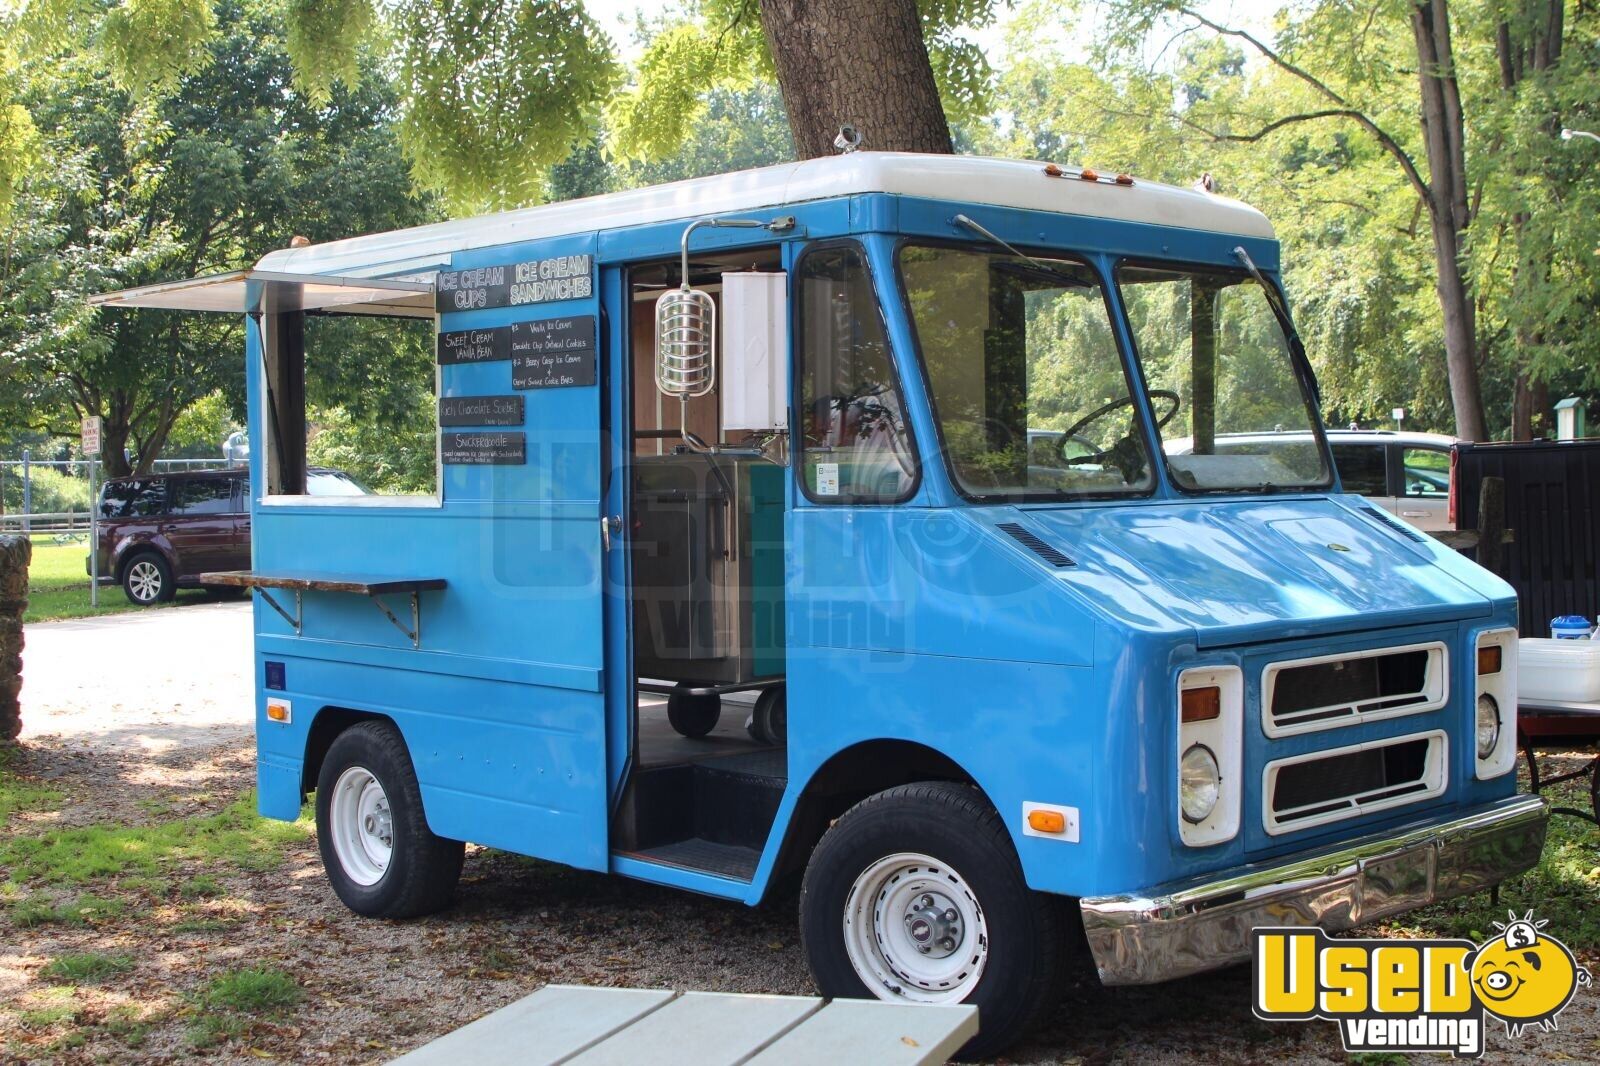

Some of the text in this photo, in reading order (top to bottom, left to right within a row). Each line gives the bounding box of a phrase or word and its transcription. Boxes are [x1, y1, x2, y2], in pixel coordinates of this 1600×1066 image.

[439, 267, 504, 291] ICE CREAM
[516, 255, 588, 283] ICE CREAM
[455, 289, 486, 308] CUPS
[510, 277, 592, 305] SANDWICHES
